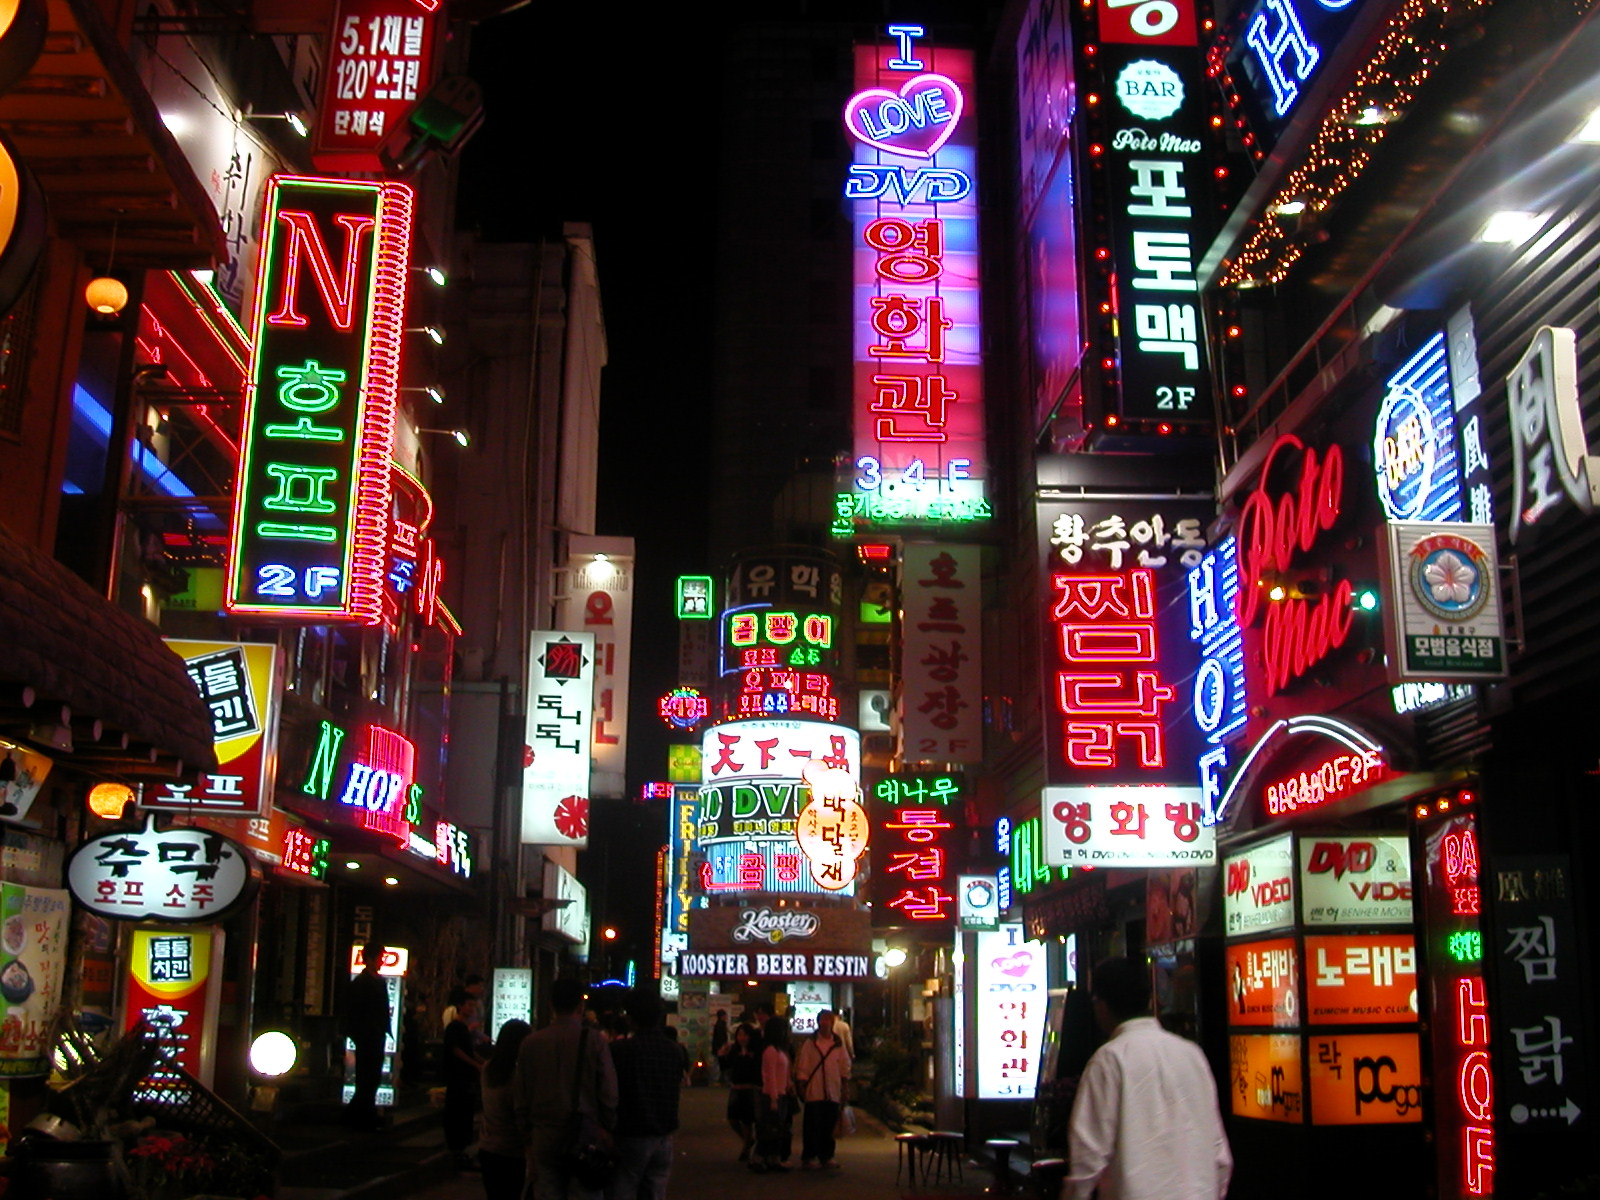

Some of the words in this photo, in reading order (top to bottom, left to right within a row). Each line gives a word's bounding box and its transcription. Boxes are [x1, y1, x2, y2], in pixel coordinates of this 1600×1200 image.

[340, 15, 424, 56] 5.1채널
[888, 25, 923, 70] I
[1125, 81, 1175, 98] BAR
[334, 110, 385, 137] 단체석
[859, 88, 952, 141] LOVE
[1159, 131, 1201, 153] Mac
[845, 164, 972, 206] DVD
[267, 210, 376, 328] N
[1127, 159, 1200, 371] 포토맥
[864, 217, 957, 442] 영화관
[1156, 386, 1196, 410] 2F
[256, 359, 347, 541] 호프
[258, 564, 340, 597] 2F
[1415, 637, 1494, 658] 모범음식점
[744, 671, 830, 697] 오페라
[1055, 569, 1175, 769] 찜닭
[710, 732, 850, 776] 天下一品
[918, 739, 969, 753] 2F
[876, 778, 960, 805] 대나무
[1053, 801, 1201, 844] 영화방
[885, 810, 953, 919] 통겹살
[1307, 842, 1377, 882] DVD
[1386, 860, 1397, 873] &
[94, 880, 144, 905] 호프
[163, 884, 214, 909] 소주
[1251, 876, 1291, 908] VIDEO
[681, 954, 749, 976] KOOSTER
[756, 953, 808, 976] BEER
[1503, 915, 1574, 1087] 찜닭
